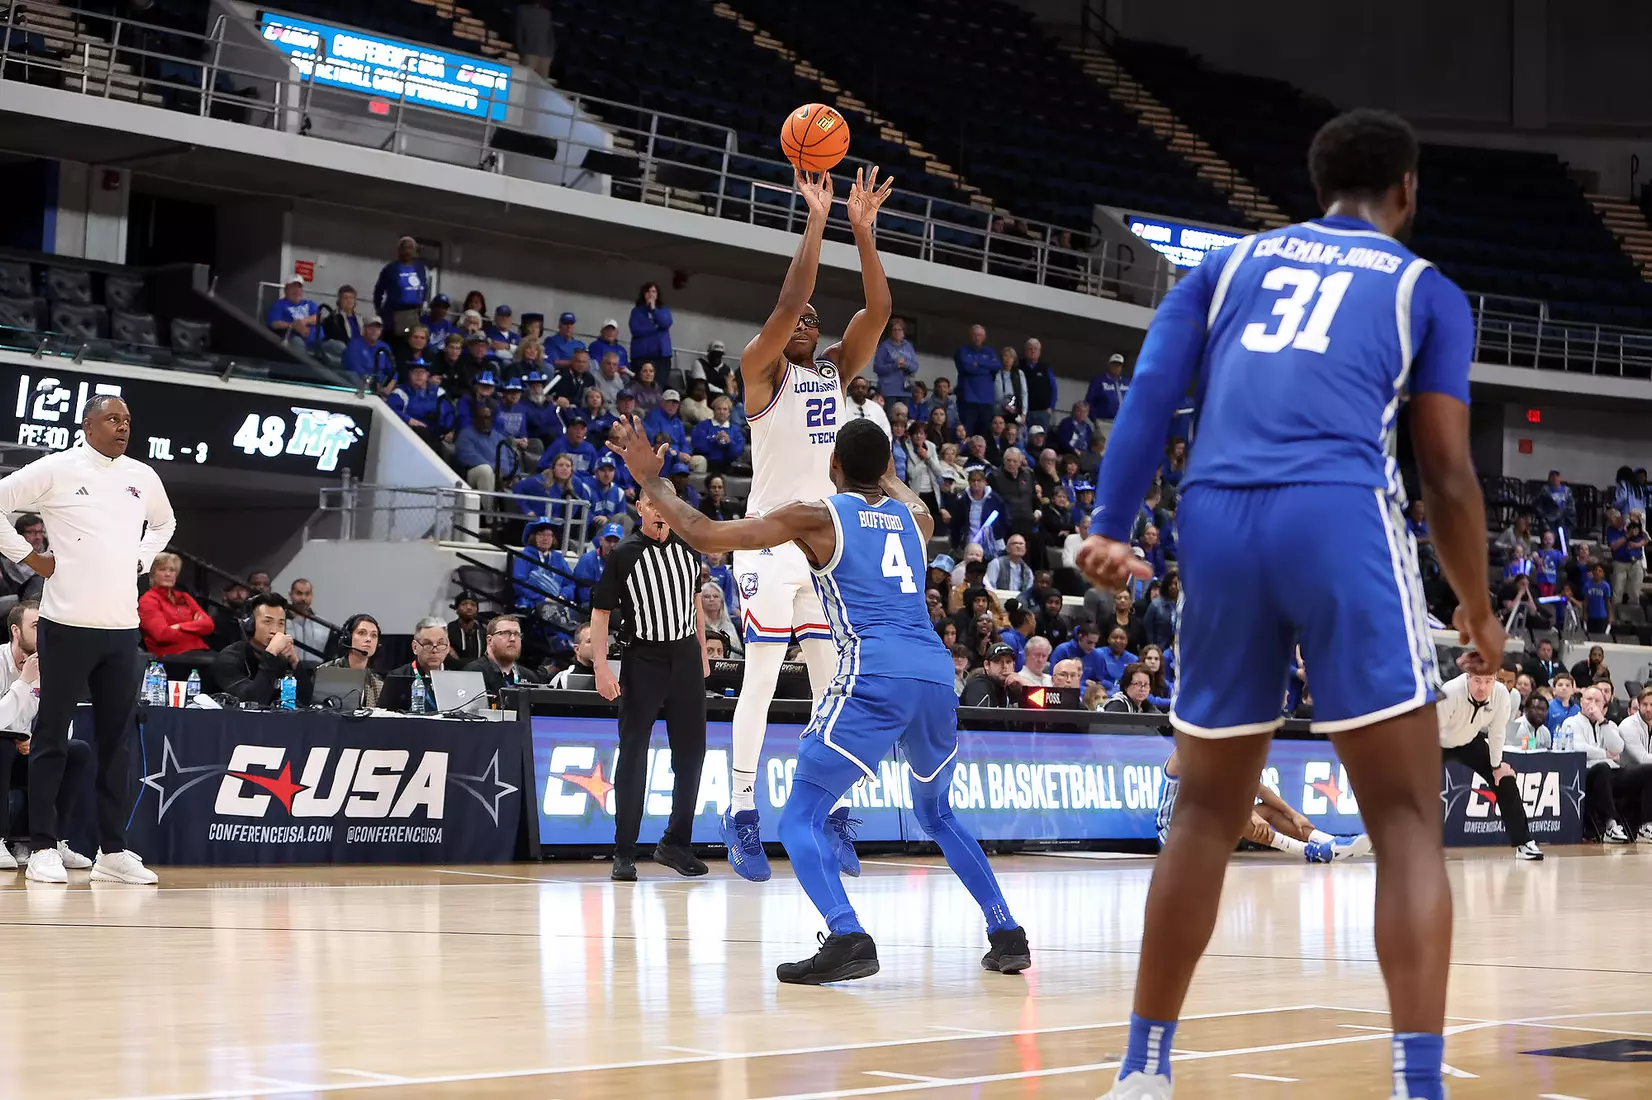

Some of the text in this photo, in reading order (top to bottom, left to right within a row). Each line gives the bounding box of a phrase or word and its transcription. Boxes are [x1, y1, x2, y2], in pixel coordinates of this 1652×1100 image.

[1240, 266, 1354, 354] 31
[806, 397, 836, 427] 22
[148, 436, 175, 461] TOL
[195, 442, 209, 464] 3
[232, 414, 286, 457] 48
[808, 431, 836, 445] TECH
[858, 510, 904, 531] BUFFORD
[881, 532, 918, 593] 4
[986, 763, 1122, 810] BASKETBALL
[208, 823, 443, 844] CONFERENCEUSA.COM @CONFERENCEUSA
